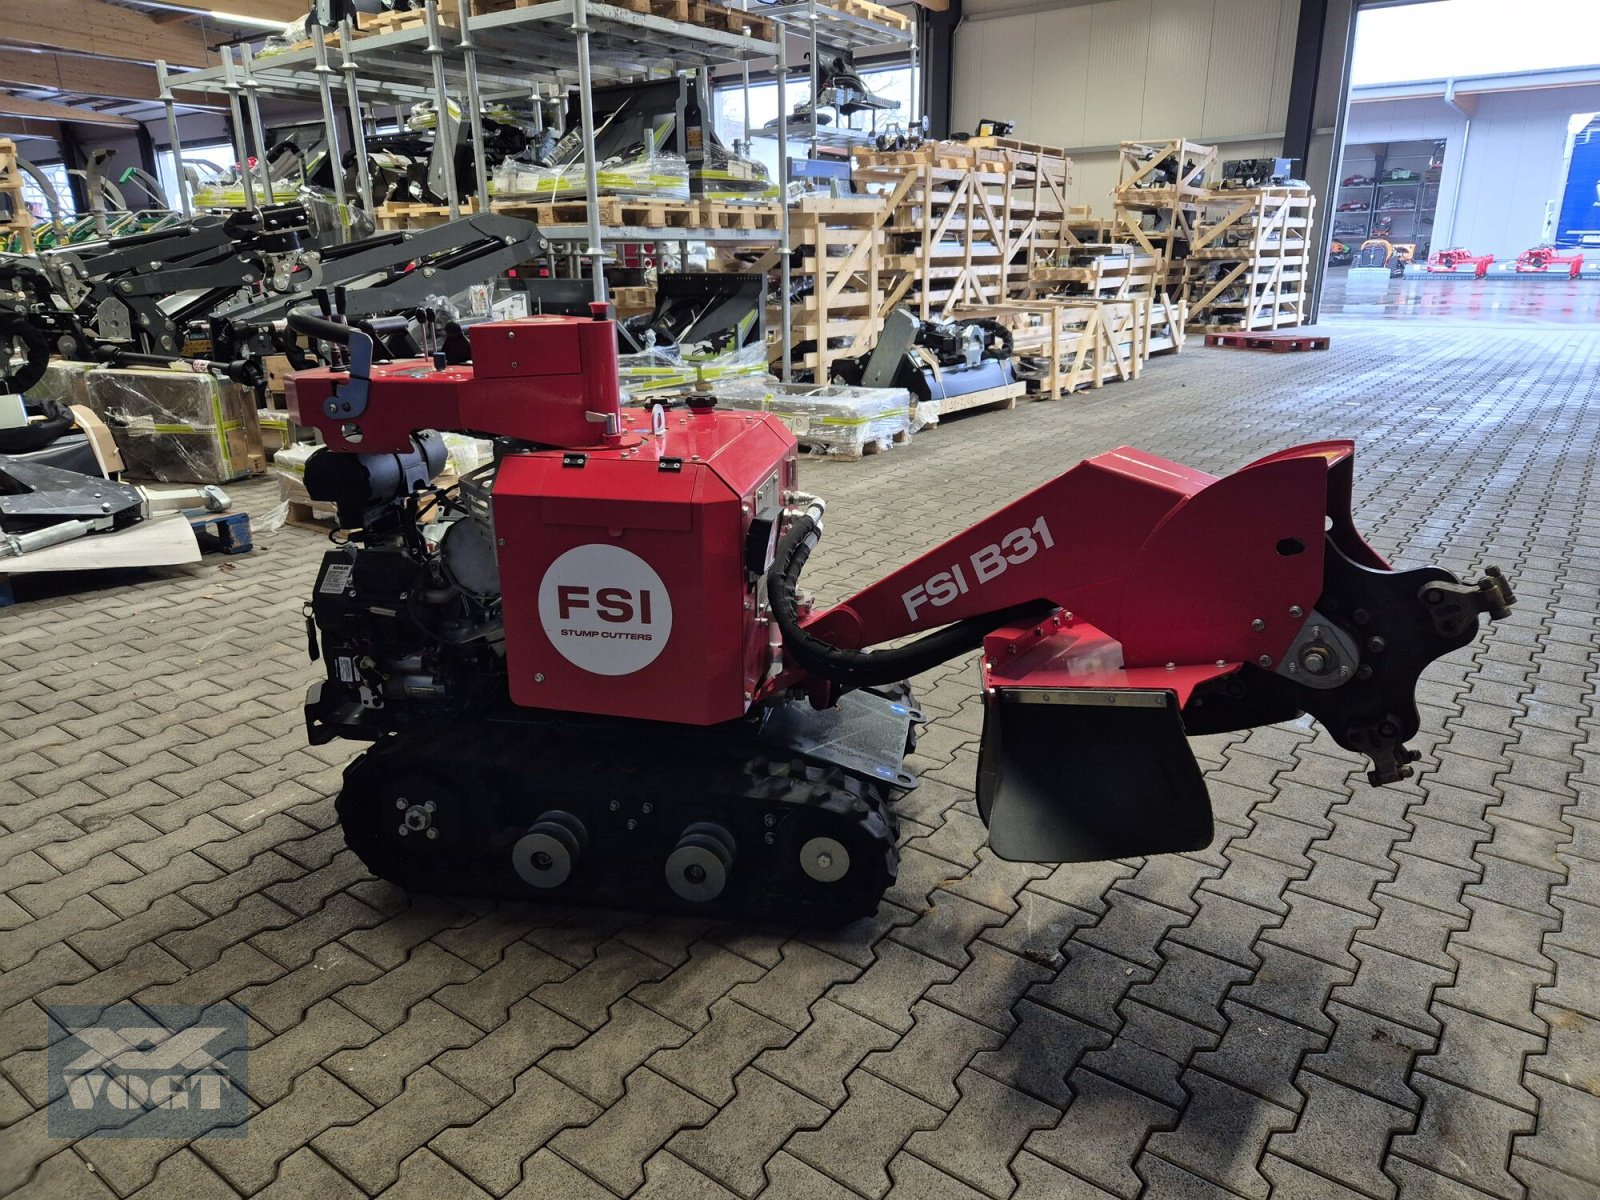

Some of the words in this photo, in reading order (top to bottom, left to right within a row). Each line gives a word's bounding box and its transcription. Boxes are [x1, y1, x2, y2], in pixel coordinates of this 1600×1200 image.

[901, 563, 969, 622] FSI
[970, 515, 1055, 585] B31
[557, 585, 652, 624] FSI
[561, 629, 600, 638] STUMP
[601, 631, 652, 641] CUTTERS
